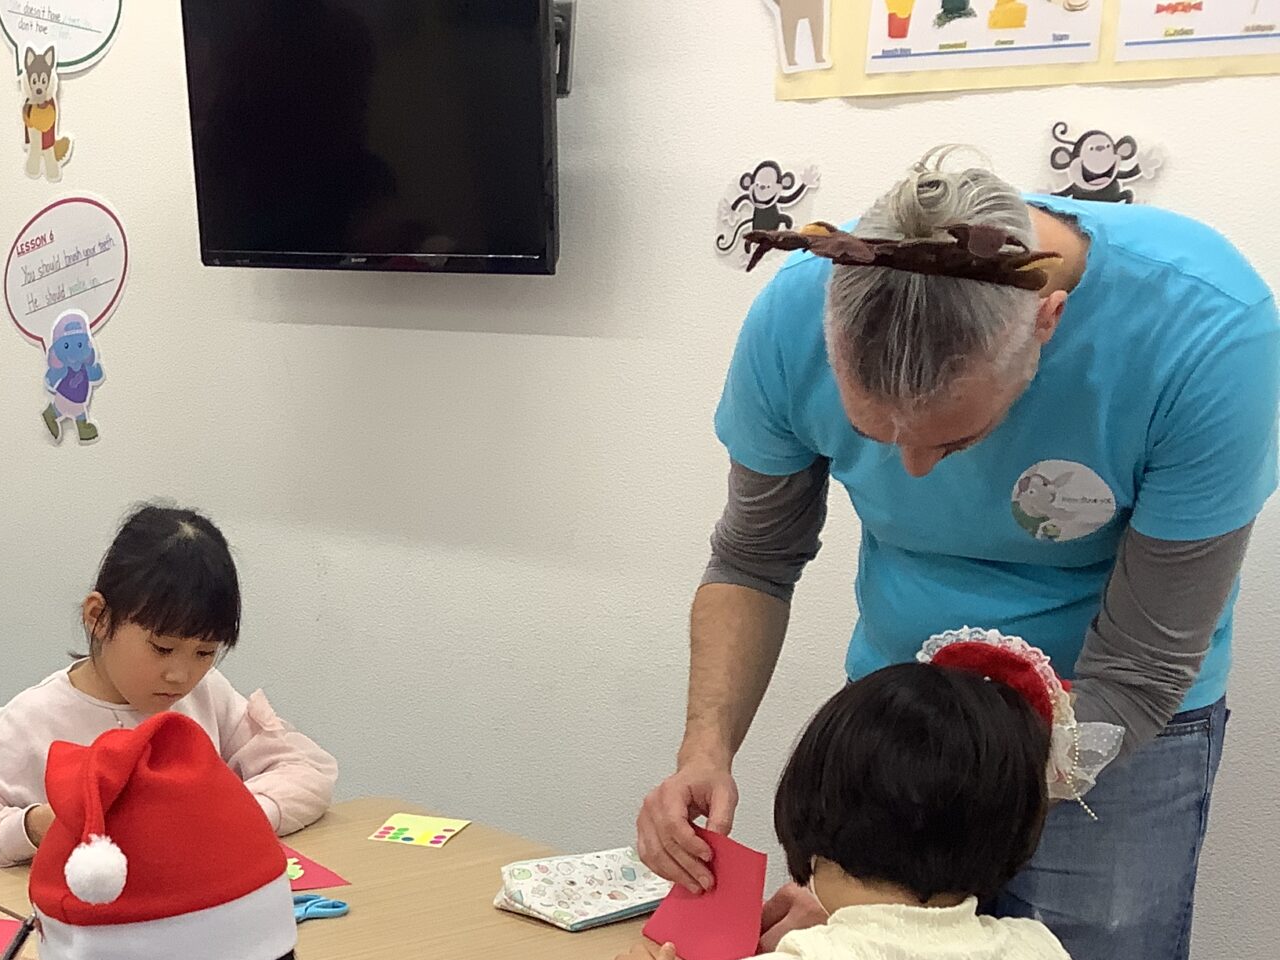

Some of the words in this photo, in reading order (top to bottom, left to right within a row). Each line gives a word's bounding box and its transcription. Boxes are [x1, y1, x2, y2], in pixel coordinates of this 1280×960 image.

[16, 233, 47, 256] LESSON
[49, 229, 54, 241] 6
[21, 264, 36, 284] You
[37, 254, 61, 277] should
